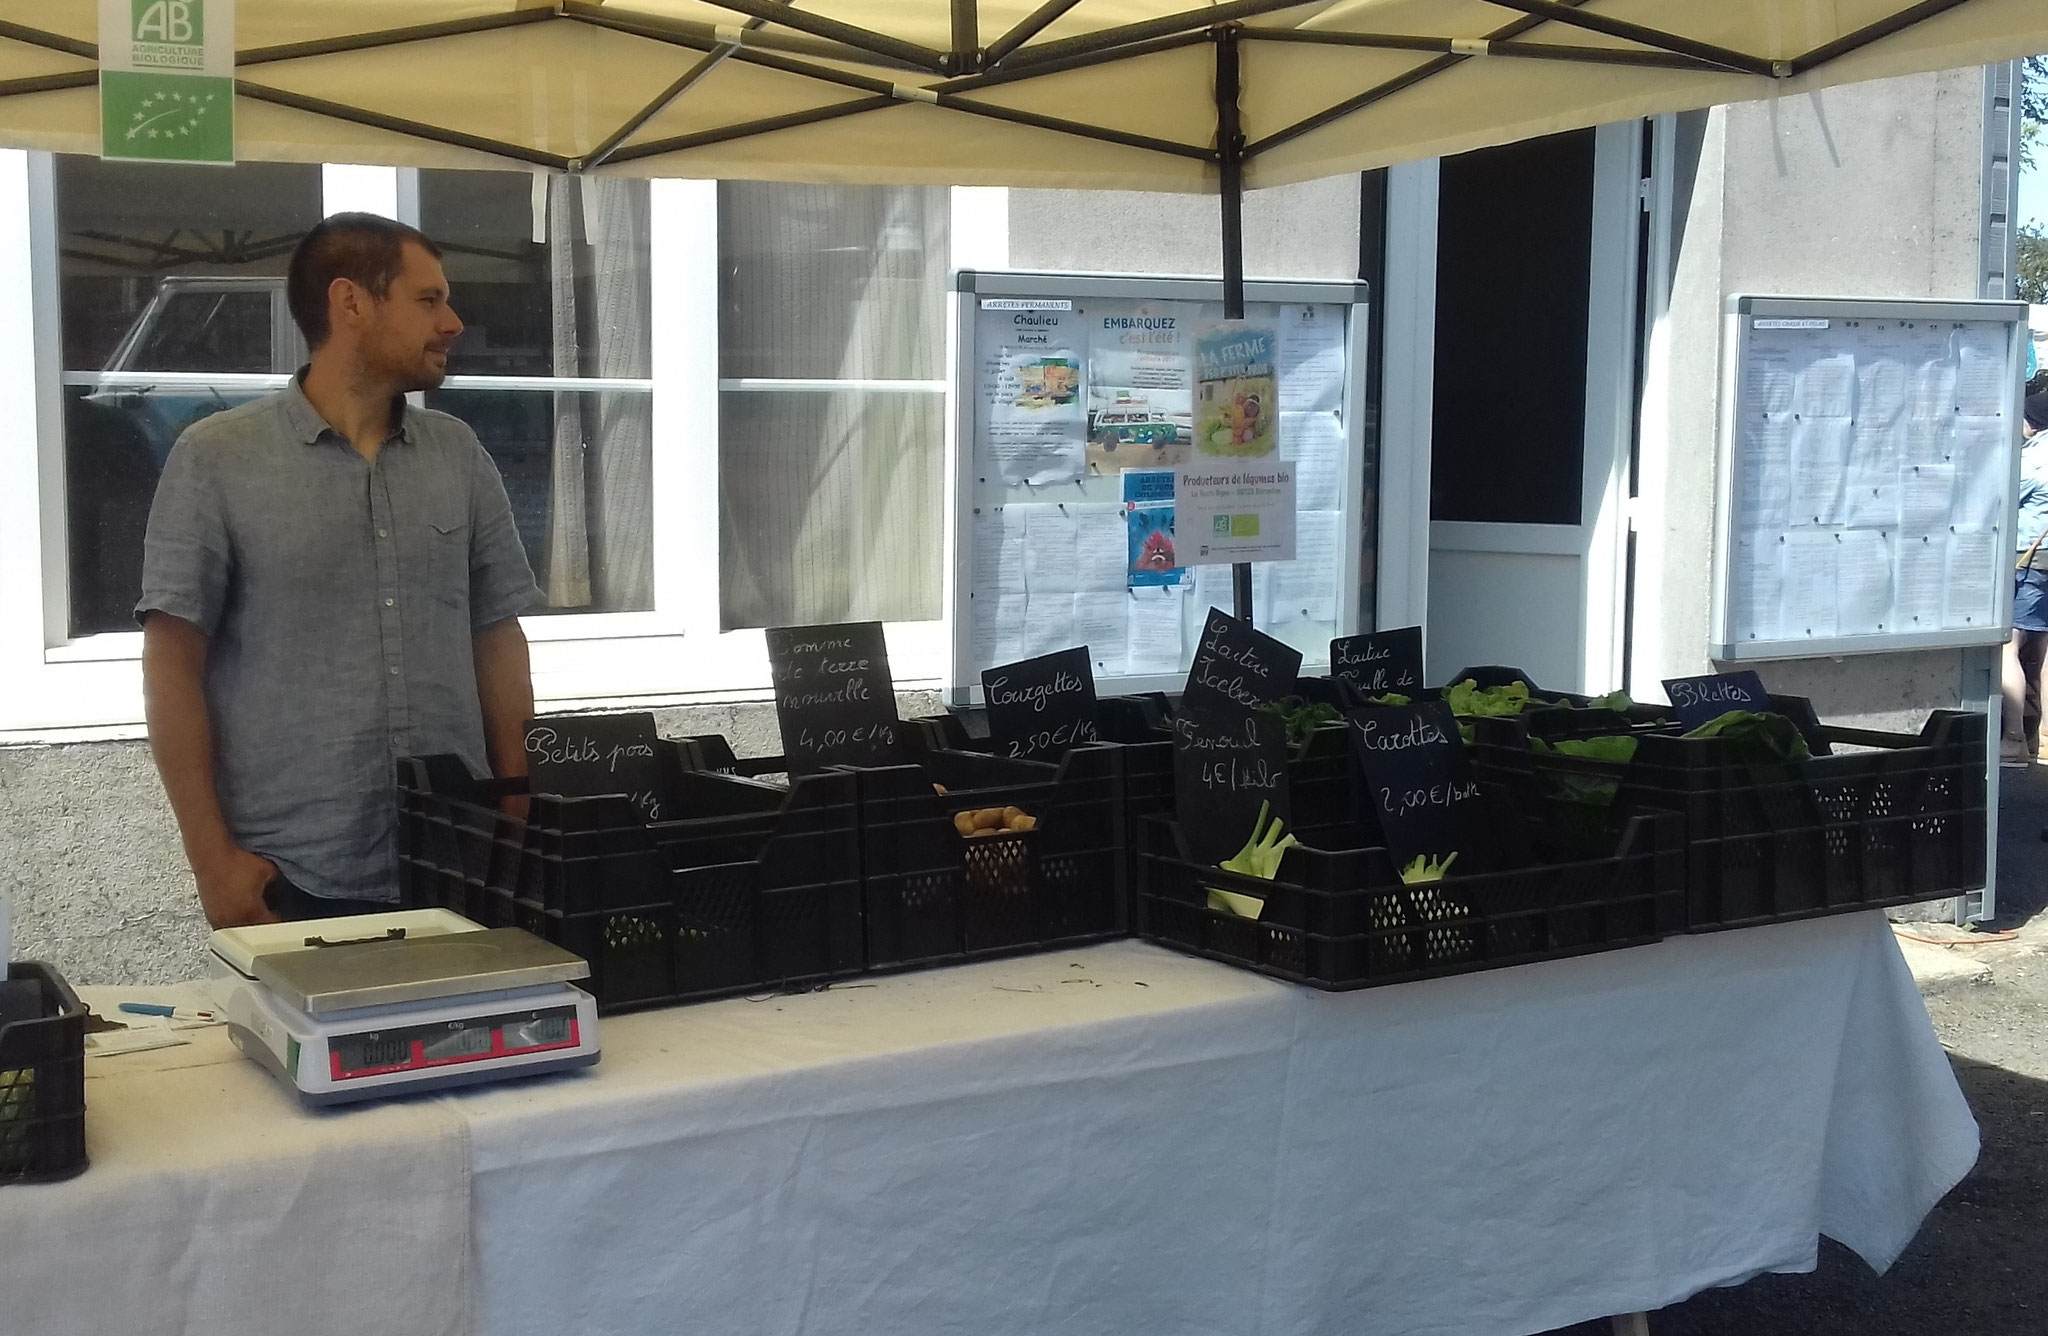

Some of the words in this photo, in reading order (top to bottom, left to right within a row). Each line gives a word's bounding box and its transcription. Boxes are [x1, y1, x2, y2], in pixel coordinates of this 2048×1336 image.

[137, 0, 193, 41] AB
[132, 45, 204, 56] AGRICULTURE
[132, 54, 204, 66] BIOLOGIQUE
[1013, 314, 1058, 326] Chaulieu
[1103, 317, 1176, 330] EMBARQUEZ
[1017, 335, 1048, 343] Marché
[1119, 331, 1145, 344] c'est
[1149, 331, 1173, 343] l'été
[1222, 337, 1266, 361] FERME
[1183, 475, 1229, 486] Producteurs
[1232, 474, 1241, 485] de
[1243, 472, 1275, 486] légumes
[1277, 472, 1289, 483] bio
[1206, 619, 1269, 678] Laitue
[1338, 640, 1390, 664] Laitue
[819, 657, 870, 677] terre
[1397, 668, 1415, 686] de
[986, 672, 1083, 712] Courgettes
[1671, 681, 1751, 708] Blettes
[1176, 718, 1261, 750] Fenouil
[1354, 714, 1448, 750] Carottes
[525, 727, 600, 765] Petits
[606, 734, 654, 773] pois
[369, 1032, 380, 1042] kg
